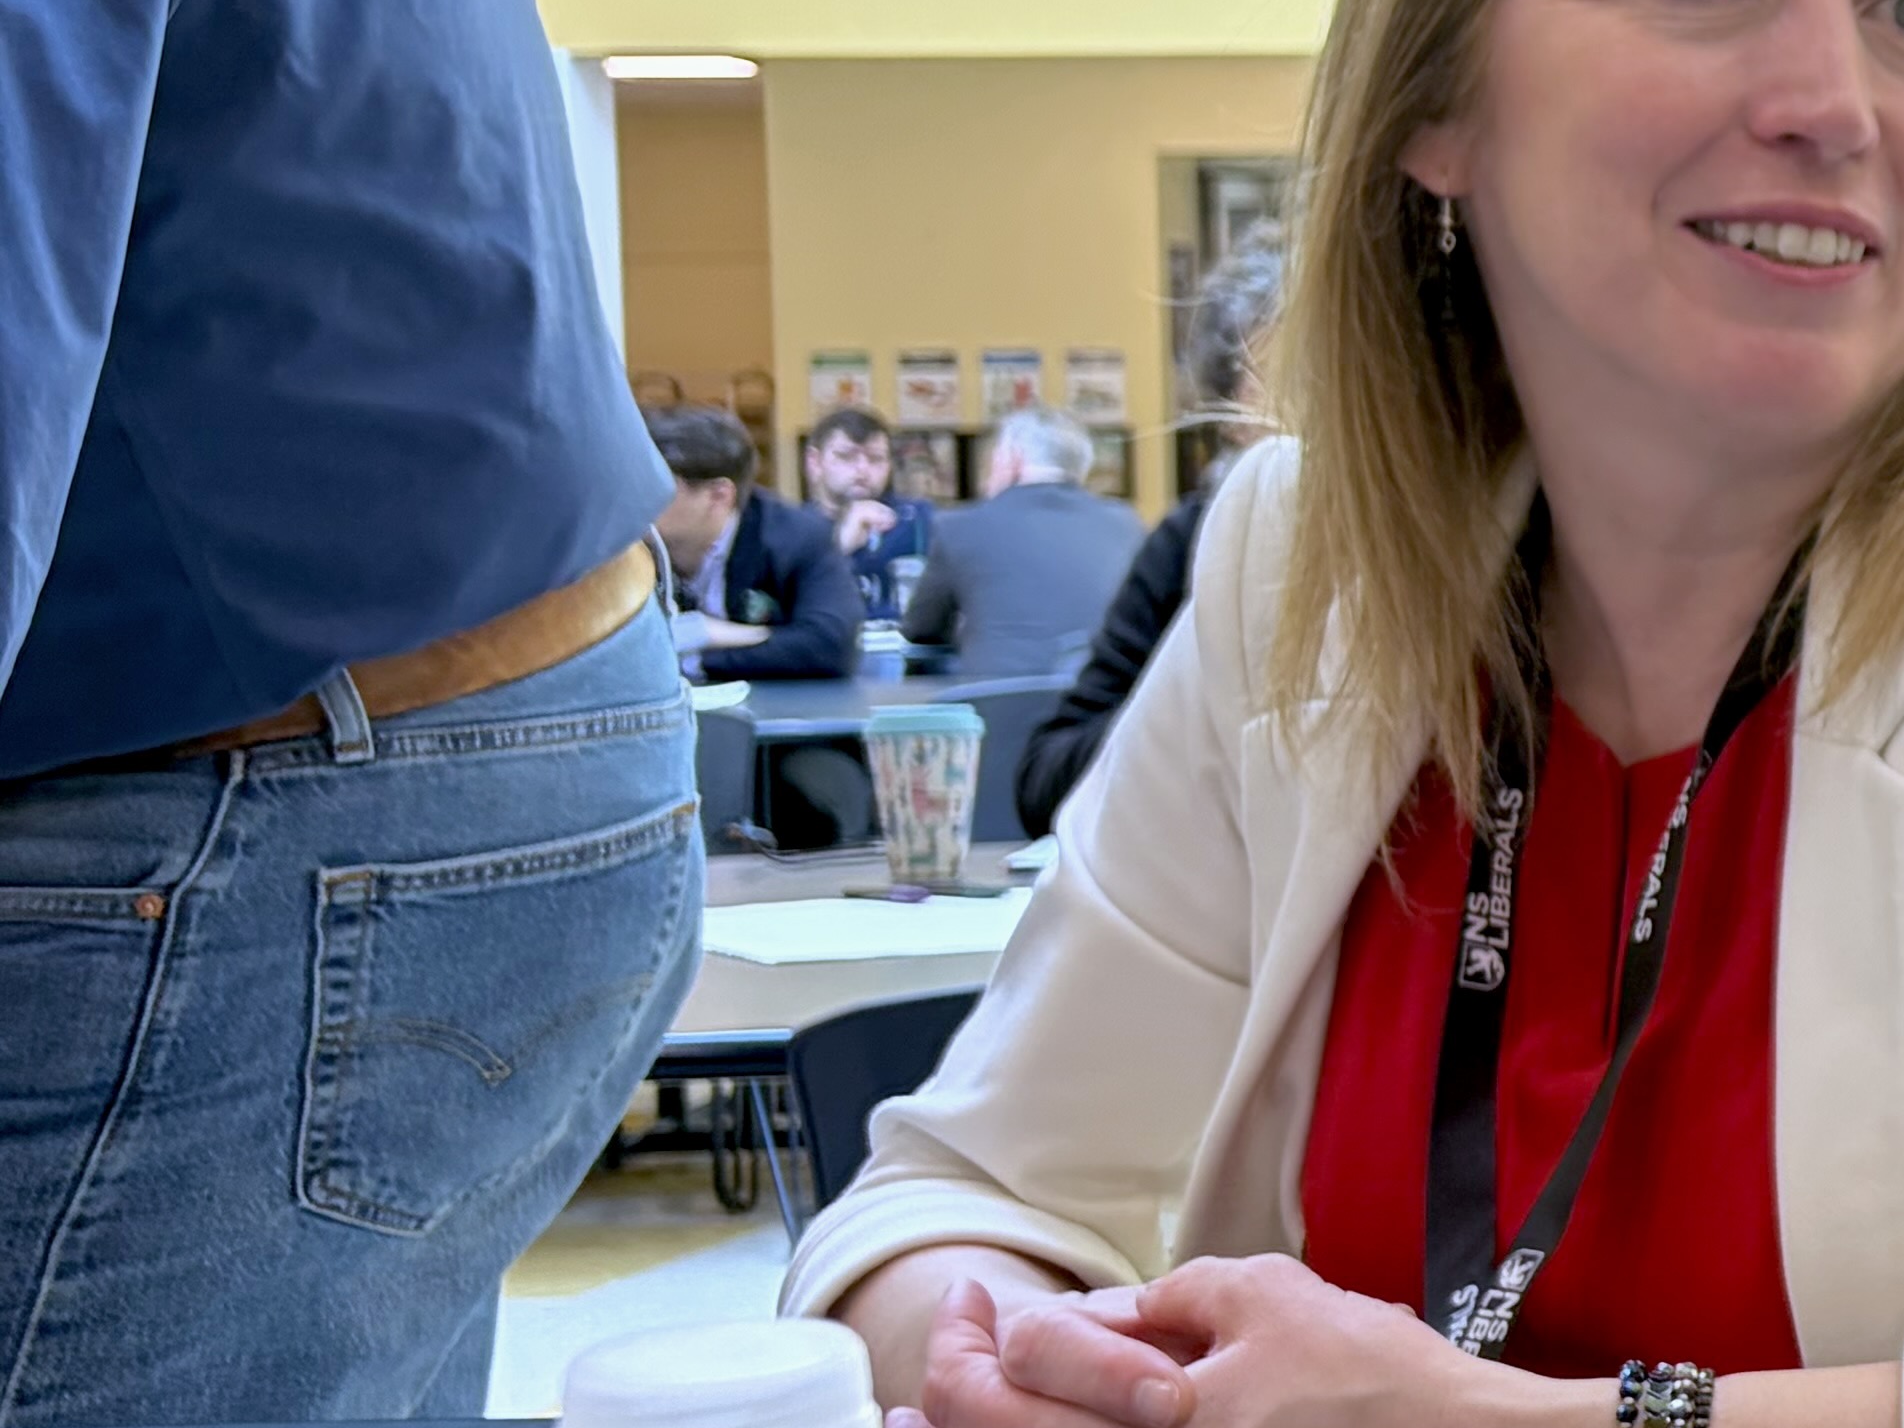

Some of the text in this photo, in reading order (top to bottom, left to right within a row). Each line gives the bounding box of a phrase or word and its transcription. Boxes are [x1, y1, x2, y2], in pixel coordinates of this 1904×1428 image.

[1489, 786, 1525, 951] LIBERALS
[1463, 891, 1491, 944] NS
[1487, 1291, 1521, 1343] NS
